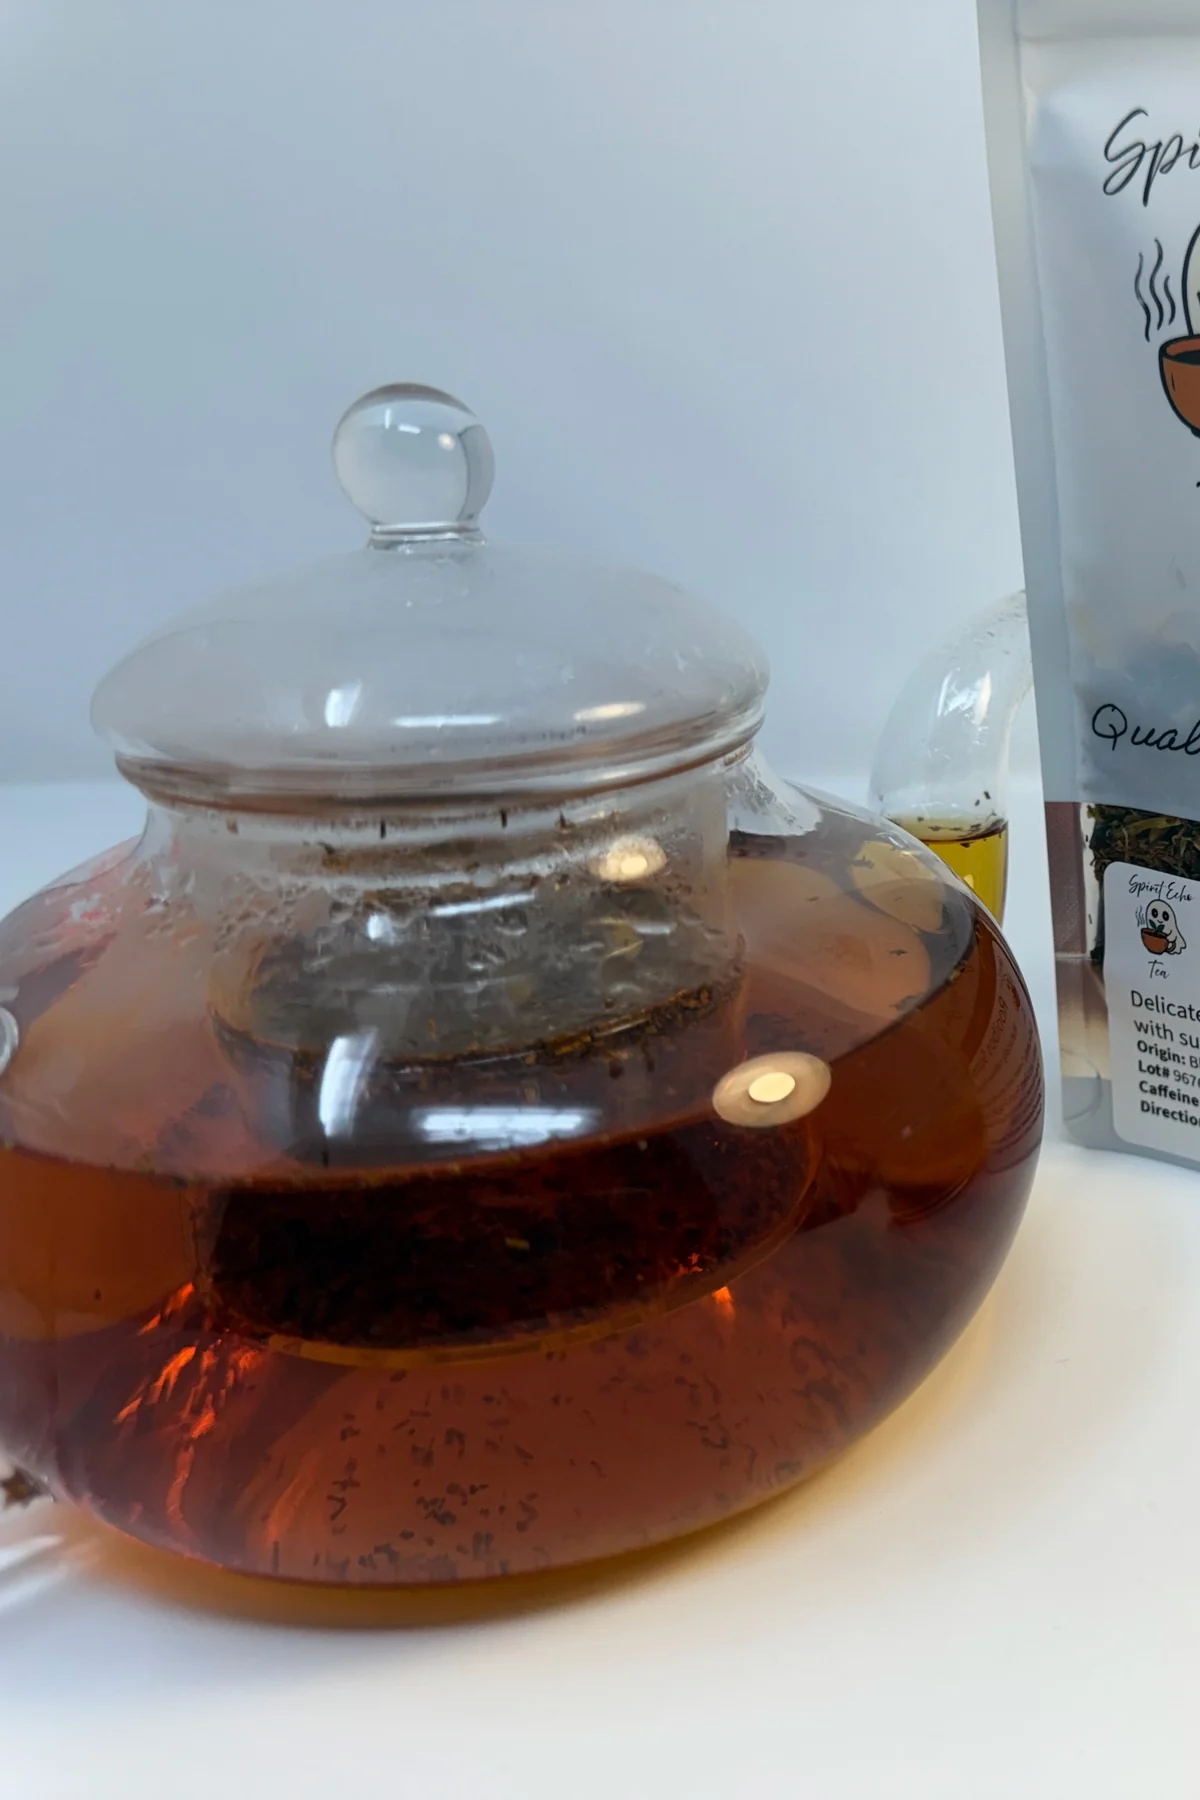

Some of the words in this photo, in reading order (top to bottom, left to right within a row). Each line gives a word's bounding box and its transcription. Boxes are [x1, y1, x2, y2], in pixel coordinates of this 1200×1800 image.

[1128, 873, 1166, 899] Spirit
[1148, 959, 1170, 979] Tea
[1133, 1020, 1174, 1042] with
[1137, 1039, 1186, 1065] Origin:
[1138, 1059, 1170, 1078] Lot#
[1139, 1080, 1199, 1107] Caffeine
